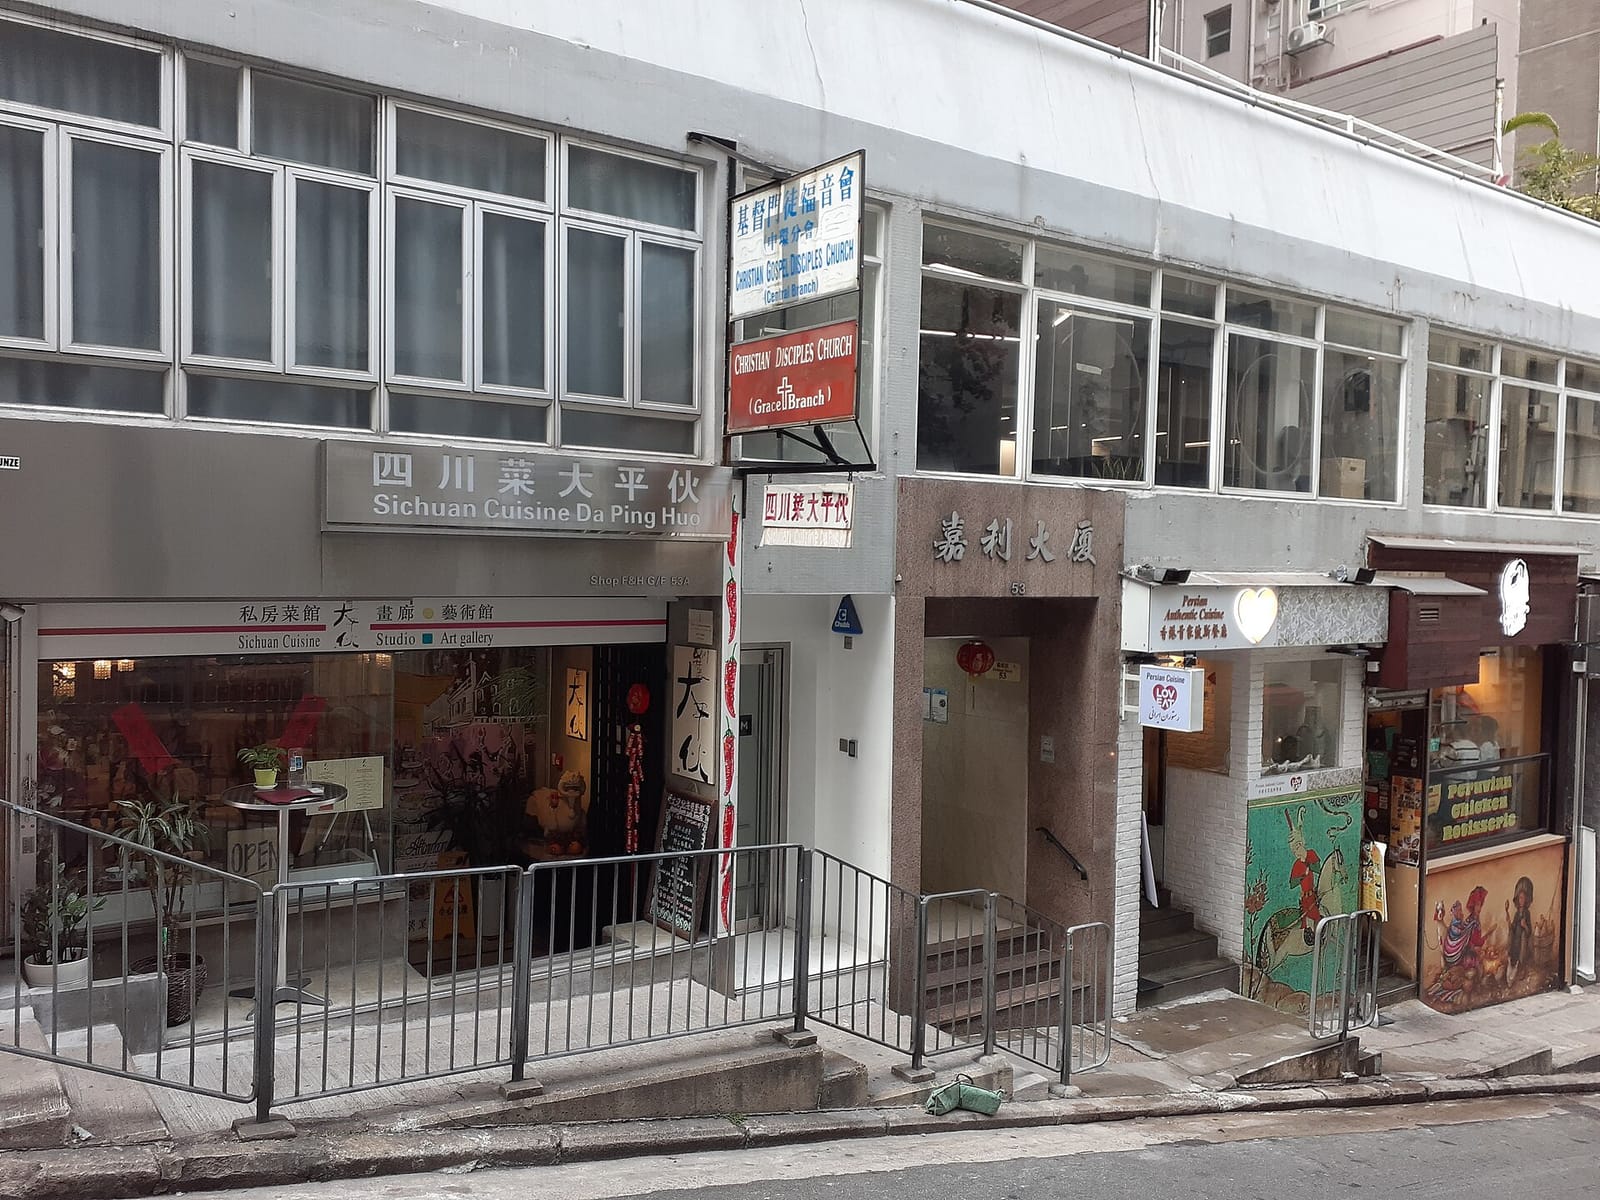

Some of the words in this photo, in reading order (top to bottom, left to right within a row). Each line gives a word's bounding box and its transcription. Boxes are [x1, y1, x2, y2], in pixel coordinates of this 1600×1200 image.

[737, 165, 854, 238] 基督門徒福音會
[735, 264, 764, 291] CHRISTIAN
[766, 258, 788, 283] GOSPEL
[790, 248, 823, 276] DISCIPLES
[825, 239, 855, 267] CHURCH
[791, 275, 819, 298] Branch)
[734, 350, 772, 375] CHRISTIAN
[775, 342, 815, 369] DISCIPLES
[817, 334, 853, 361] CHURCH
[372, 451, 701, 505] 四川菜大平伙
[373, 493, 477, 519] Sichuan
[484, 499, 571, 522] Cuisine
[575, 503, 605, 523] Da
[610, 504, 656, 529] Ping
[661, 507, 701, 526] Huo
[765, 492, 849, 524] 四川菜大平伙
[590, 575, 619, 587] Shop
[647, 575, 667, 586] G/F
[670, 575, 690, 586] 53A
[1011, 582, 1026, 595] 53
[1182, 594, 1209, 608] Persian
[239, 604, 321, 623] 私房菜館
[376, 603, 415, 622] 畫廊
[441, 603, 495, 621] 藝術館
[1164, 608, 1198, 621] Authentic
[1200, 608, 1225, 620] Cuisine
[238, 634, 279, 649] Sichuan
[282, 633, 321, 649] Cuisine
[376, 631, 416, 646] Studio
[441, 631, 457, 645] Art
[459, 630, 494, 647] gallery
[1146, 671, 1165, 682] Persian
[1166, 673, 1186, 684] Cuisine
[1156, 687, 1175, 699] LOV
[231, 840, 278, 873] OPEN
